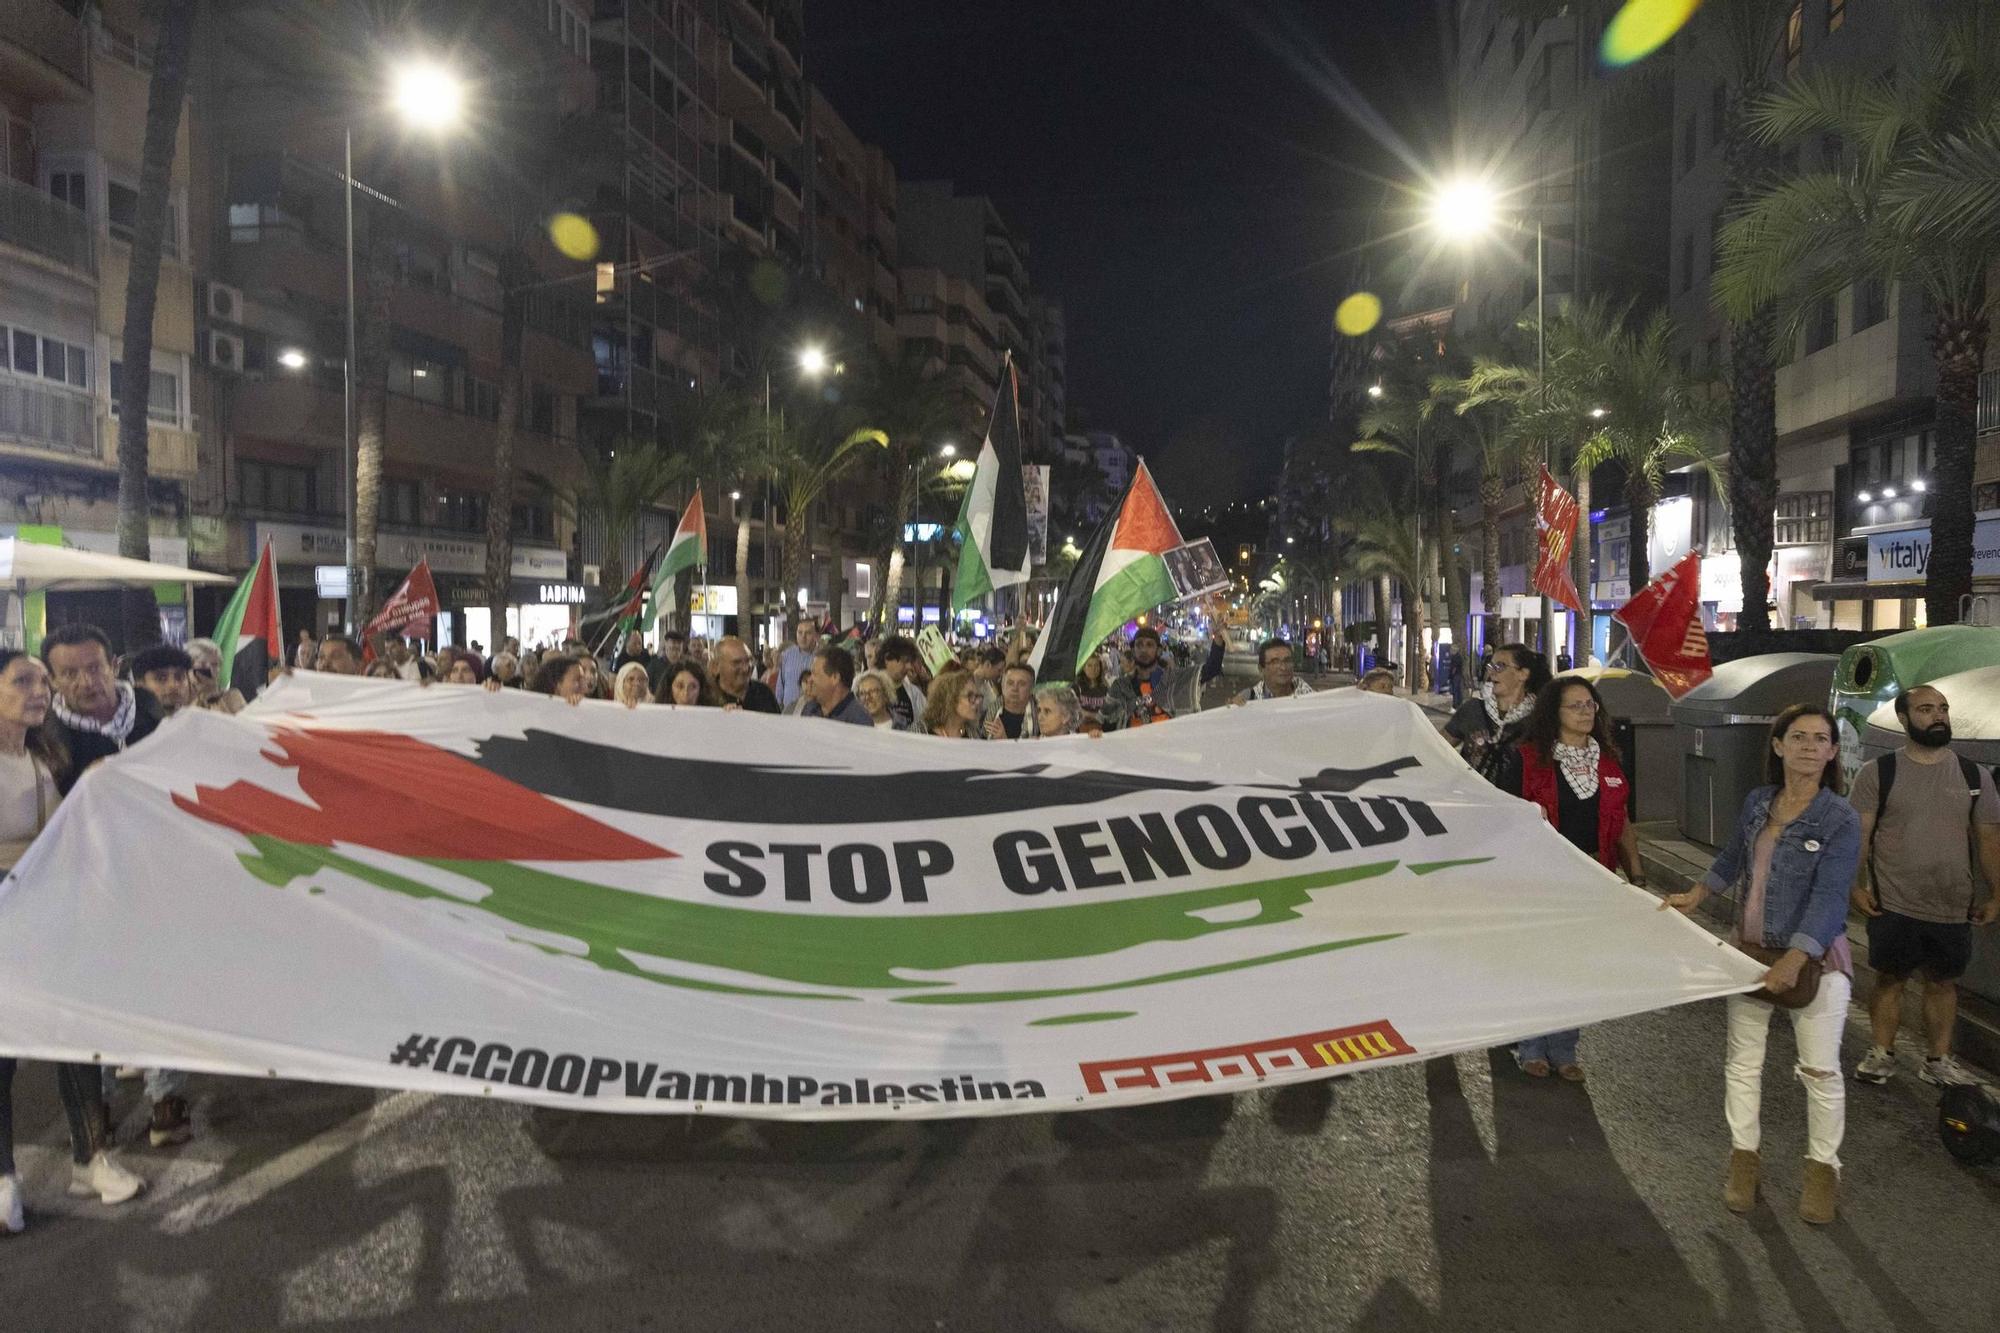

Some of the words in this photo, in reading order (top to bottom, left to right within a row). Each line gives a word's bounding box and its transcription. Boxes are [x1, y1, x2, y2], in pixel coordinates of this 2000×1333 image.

[1880, 540, 1930, 574] vitaly
[703, 839, 955, 904] STOP
[992, 792, 1448, 896] GENOCIDI
